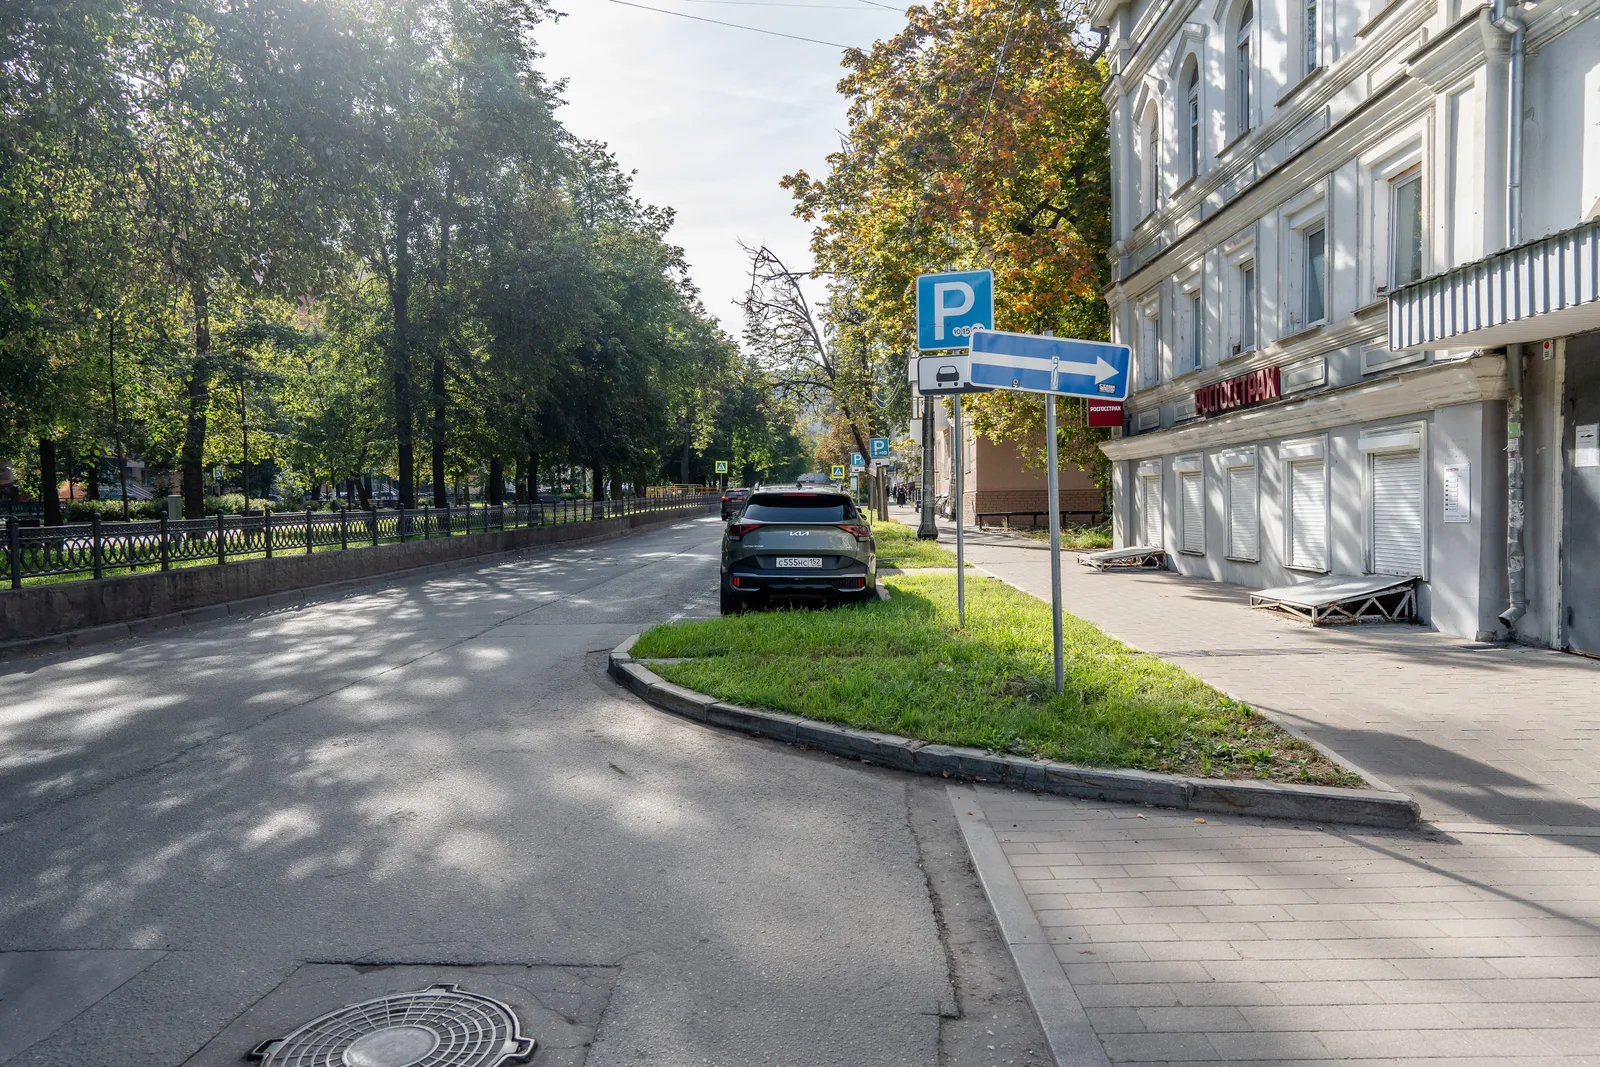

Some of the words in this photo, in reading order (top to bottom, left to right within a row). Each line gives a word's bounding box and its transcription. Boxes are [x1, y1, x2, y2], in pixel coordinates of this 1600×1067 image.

[934, 281, 975, 340] P
[1196, 367, 1276, 415] РОСГОССТРАХ
[854, 454, 862, 464] P
[874, 440, 884, 455] P
